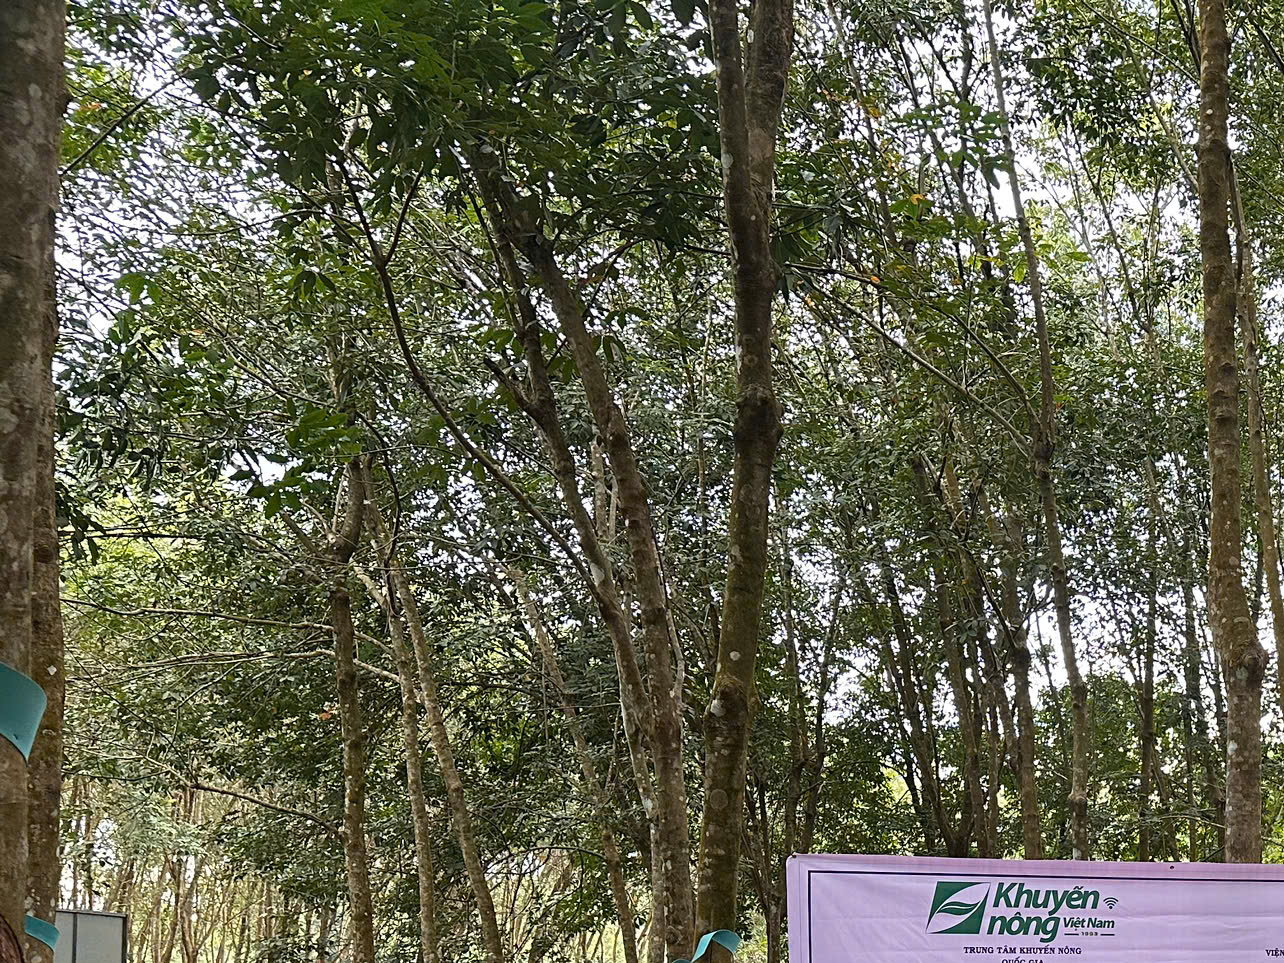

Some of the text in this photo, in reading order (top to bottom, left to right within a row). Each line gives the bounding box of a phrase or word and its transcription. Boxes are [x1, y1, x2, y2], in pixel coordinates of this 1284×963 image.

[986, 911, 1060, 943] nông
[1063, 917, 1115, 932] Việt Nam
[963, 944, 1082, 955] TRUNG TÂM KHUYẾN NÔNG
[1265, 948, 1284, 958] VIỆN
